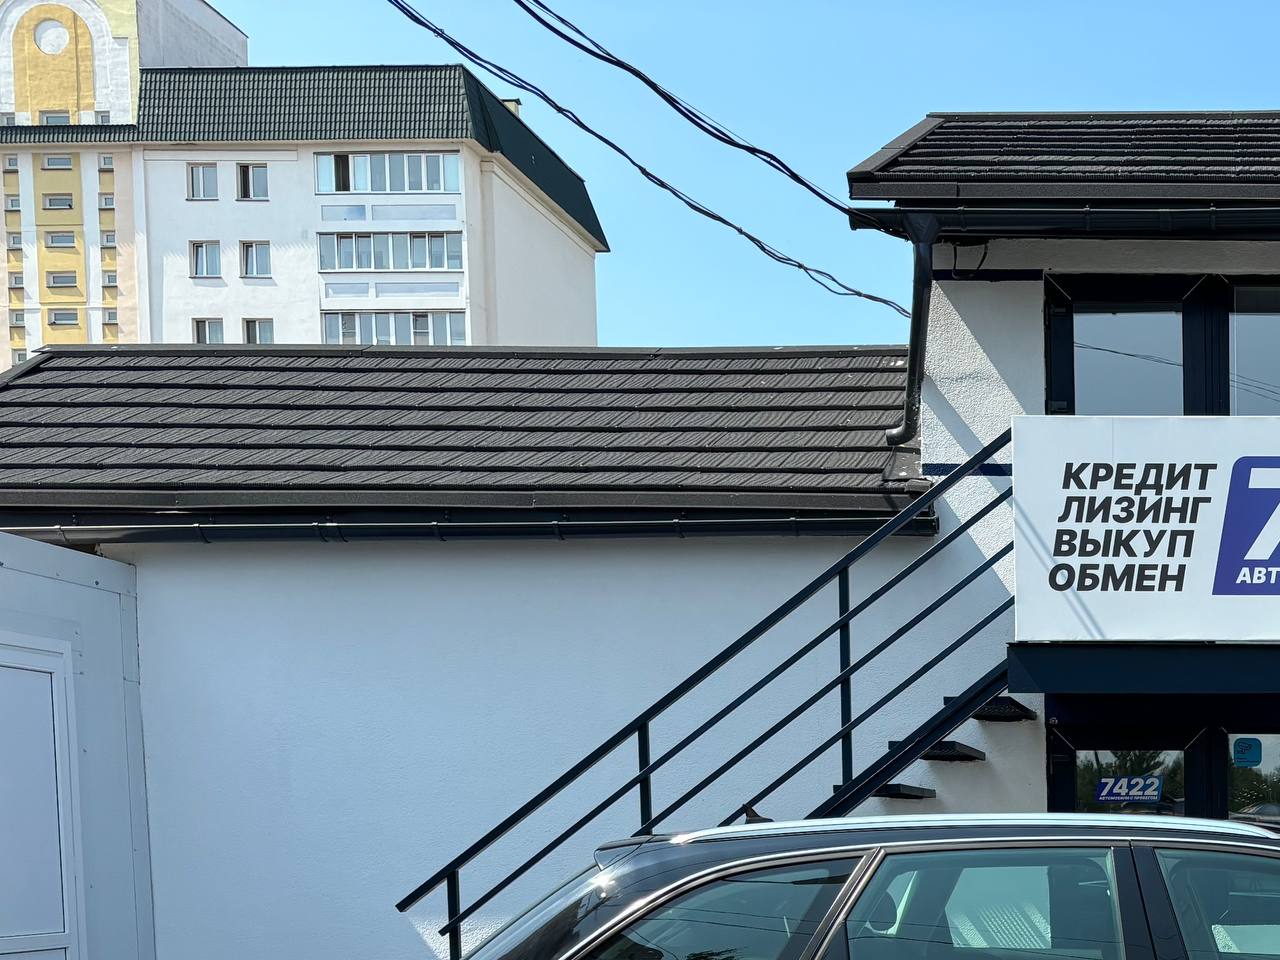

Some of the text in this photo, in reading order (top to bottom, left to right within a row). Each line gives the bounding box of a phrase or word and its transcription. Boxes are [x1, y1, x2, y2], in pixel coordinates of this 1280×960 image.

[1062, 462, 1218, 495] КРЕДИТ
[1057, 495, 1212, 524] ЛИЗИНГ
[1052, 528, 1195, 558] ВЫКУП
[1048, 562, 1187, 592] ОБМЕН
[1100, 777, 1160, 796] 7422
